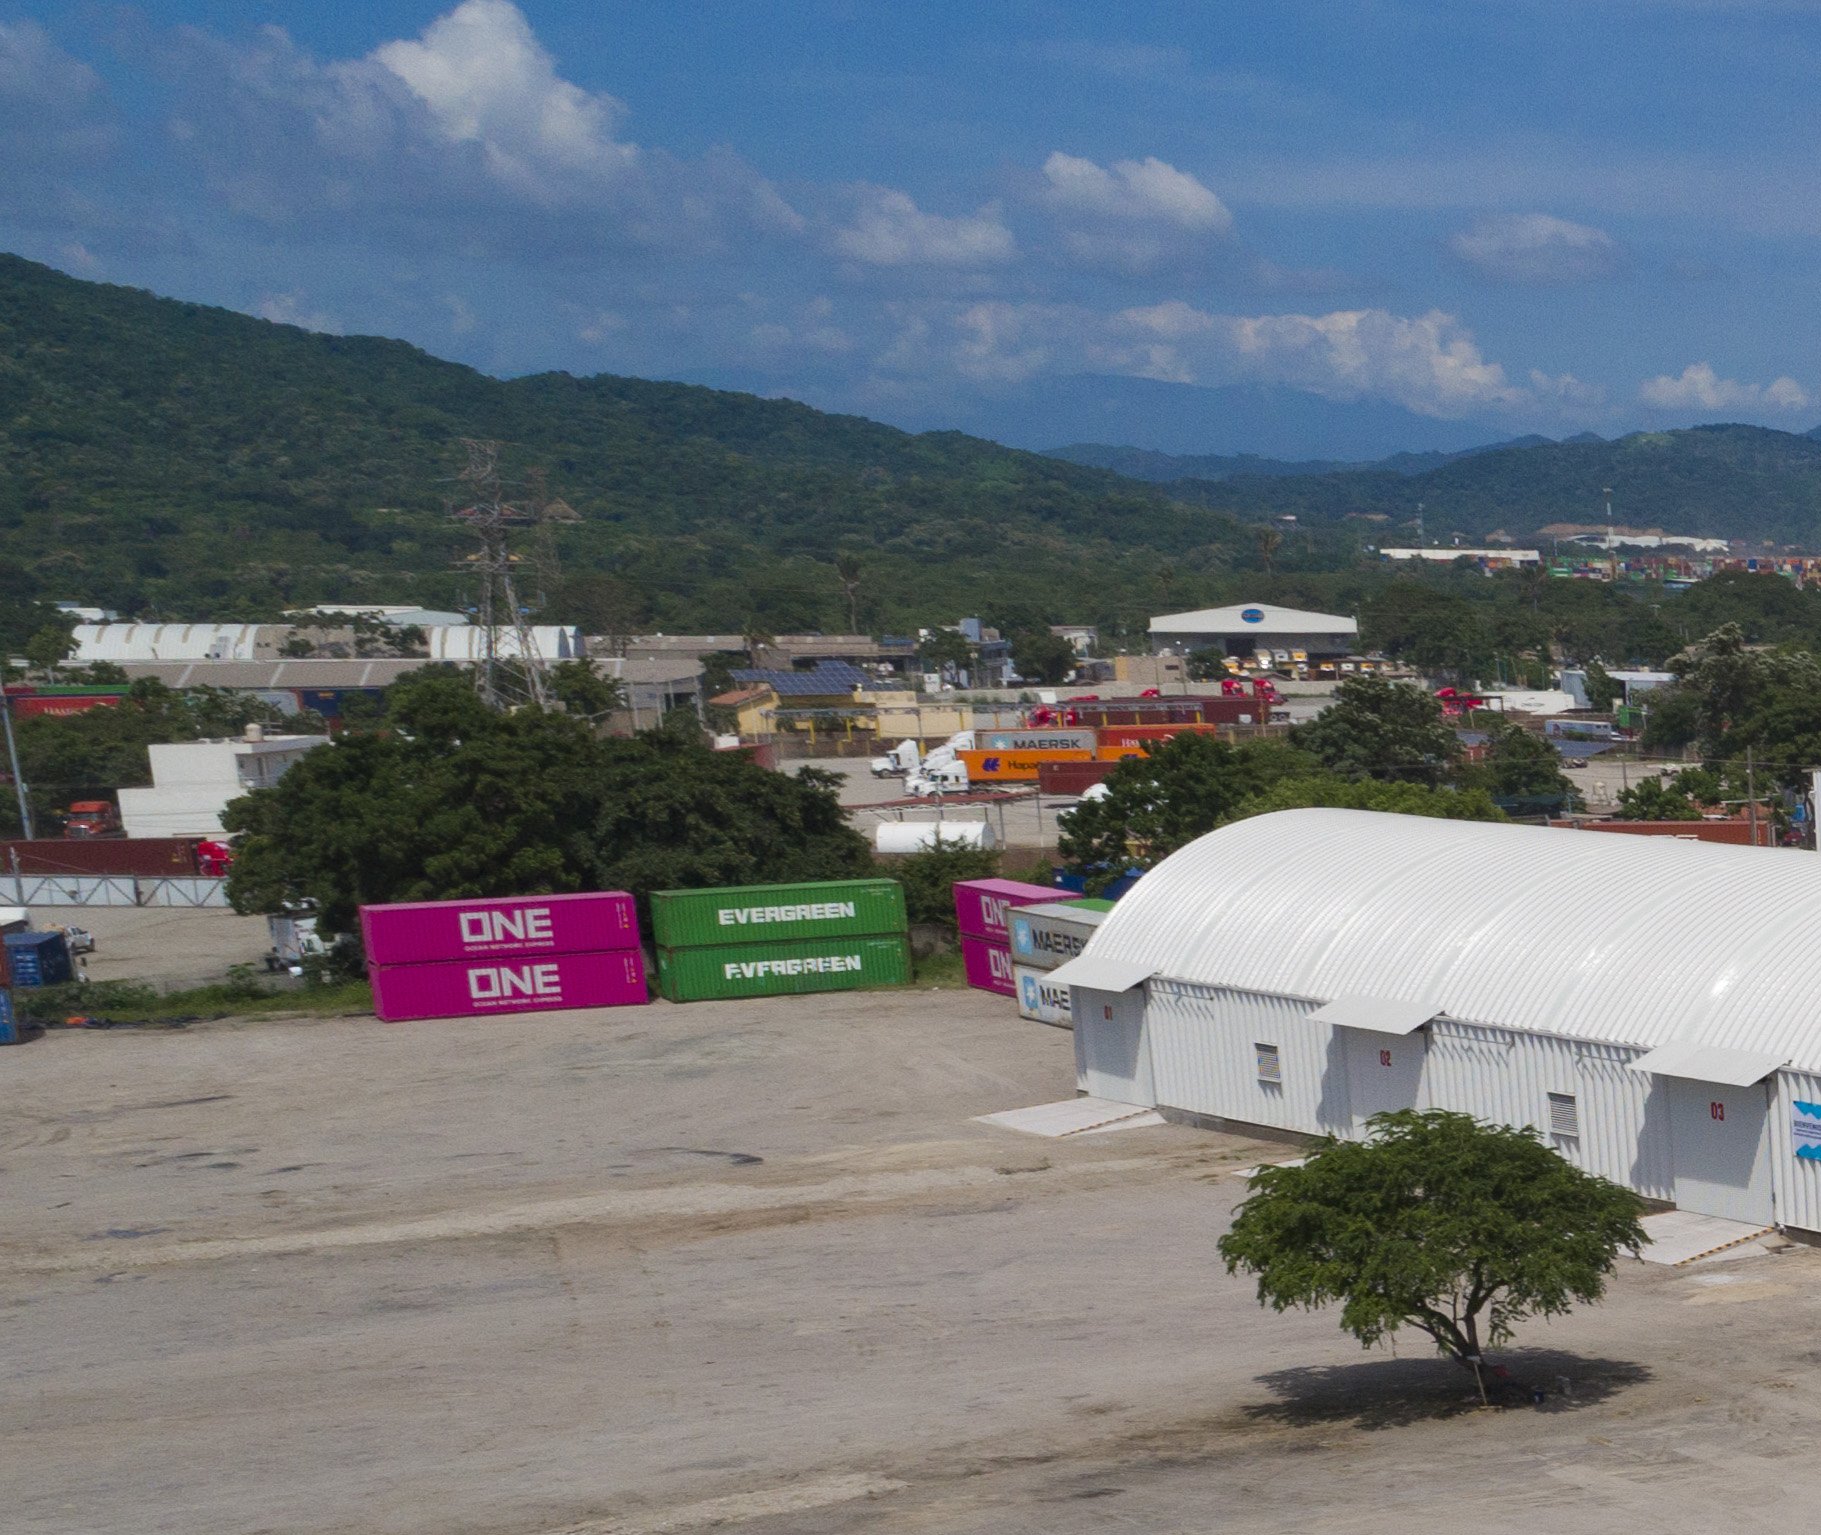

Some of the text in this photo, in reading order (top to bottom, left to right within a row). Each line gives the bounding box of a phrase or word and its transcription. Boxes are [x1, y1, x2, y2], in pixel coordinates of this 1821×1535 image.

[1013, 738, 1081, 750] MAERSK
[718, 901, 856, 926] EVERGREEN
[459, 907, 554, 943] ONE
[467, 964, 562, 999] ONE
[1379, 1049, 1392, 1067] 02
[1710, 1101, 1724, 1121] 03
